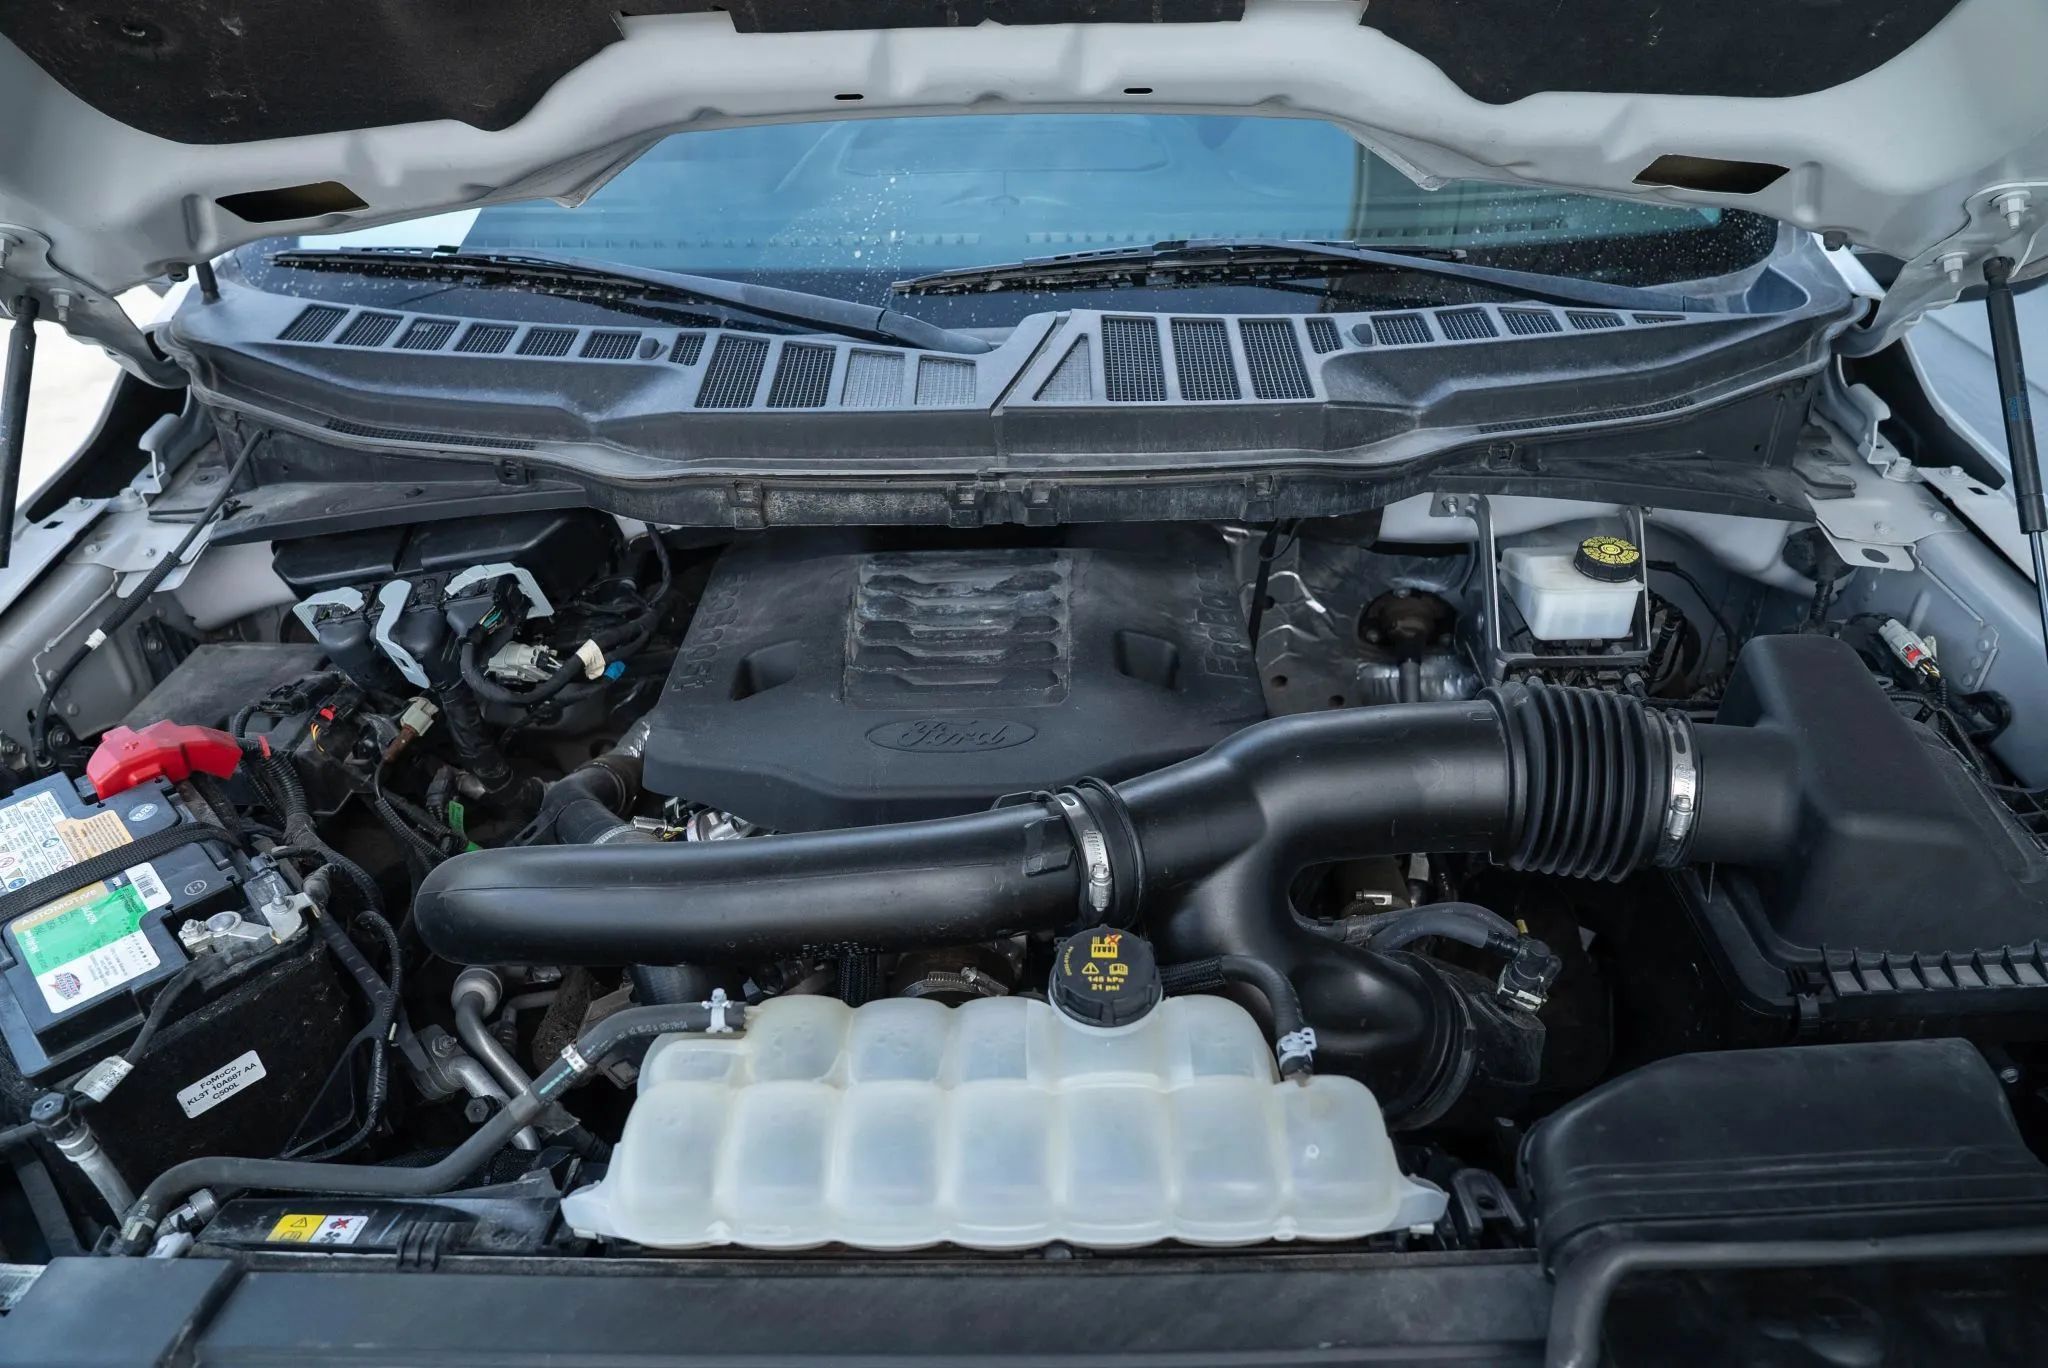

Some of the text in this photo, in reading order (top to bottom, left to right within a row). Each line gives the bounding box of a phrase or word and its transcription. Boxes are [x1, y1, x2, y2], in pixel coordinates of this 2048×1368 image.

[897, 719, 1009, 748] Ford
[21, 888, 98, 926] AUTOMOTIVE
[1105, 984, 1120, 992] psi
[187, 1062, 257, 1106] KL3T 10A687 AA
[199, 1066, 237, 1090] FoMoCo
[212, 1083, 240, 1100] C500L
